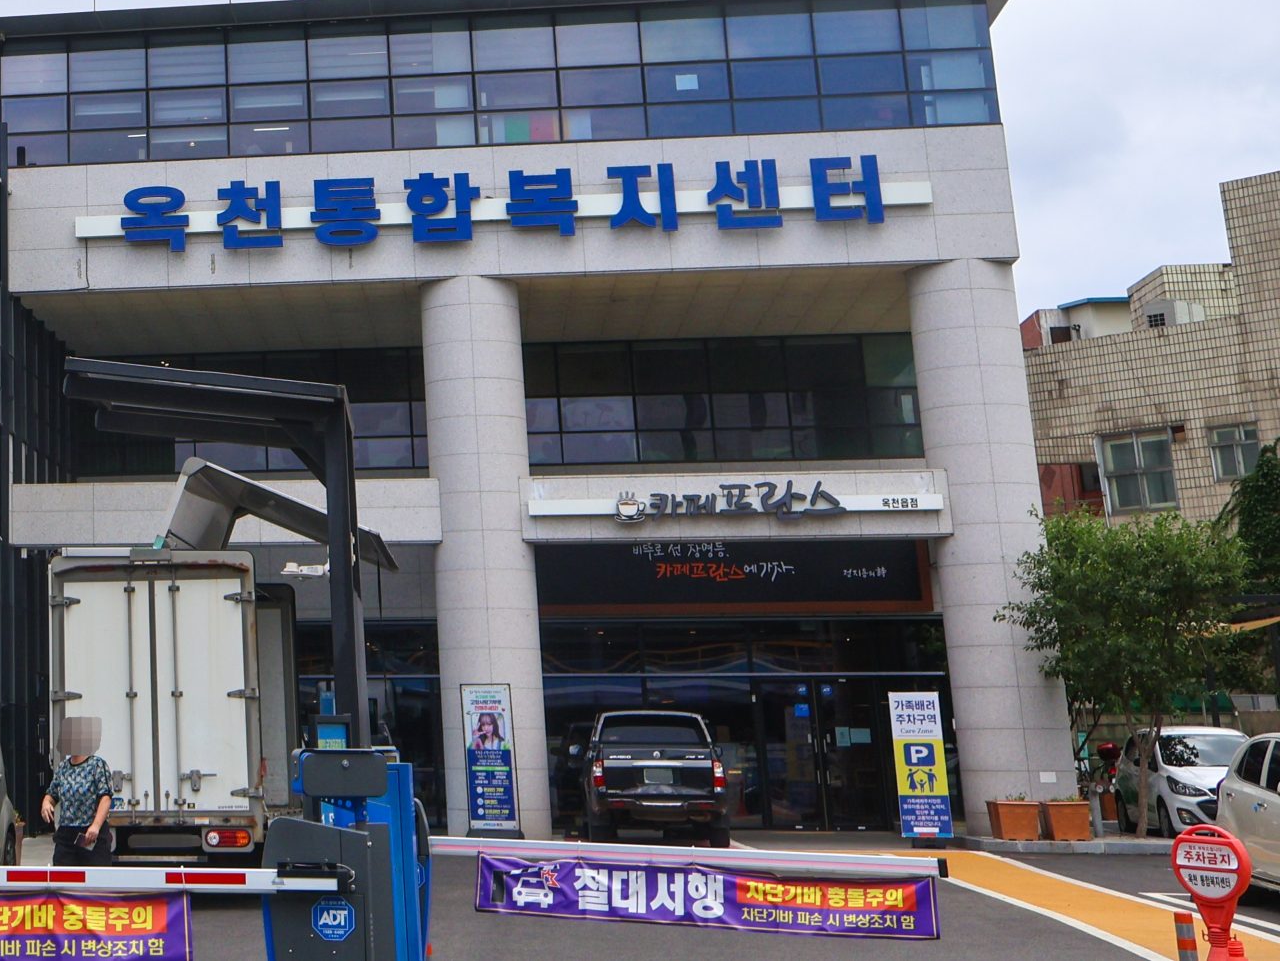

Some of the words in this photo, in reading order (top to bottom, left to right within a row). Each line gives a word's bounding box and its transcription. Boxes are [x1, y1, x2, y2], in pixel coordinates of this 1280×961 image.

[120, 154, 886, 253] 옥천통합복지센터
[649, 480, 847, 521] 카페프란스
[882, 497, 919, 509] 옥천읍점
[894, 699, 936, 712] 가족배려
[896, 713, 937, 725] 주차구역
[910, 746, 929, 764] P
[1184, 850, 1231, 866] 주차금지
[573, 868, 725, 919] 절대서행
[746, 881, 822, 905] 차단기바
[827, 886, 904, 907] 충돌주의
[62, 904, 154, 932] 충돌주의
[319, 910, 348, 926] ADT
[741, 907, 793, 924] 차단기바
[797, 911, 822, 926] 파손
[827, 913, 839, 926] 시
[843, 913, 897, 929] 변상조치
[900, 915, 915, 930] 함
[25, 939, 56, 957] 파손
[60, 939, 75, 957] 시
[81, 939, 144, 958] 변상조치
[148, 938, 165, 956] 함
